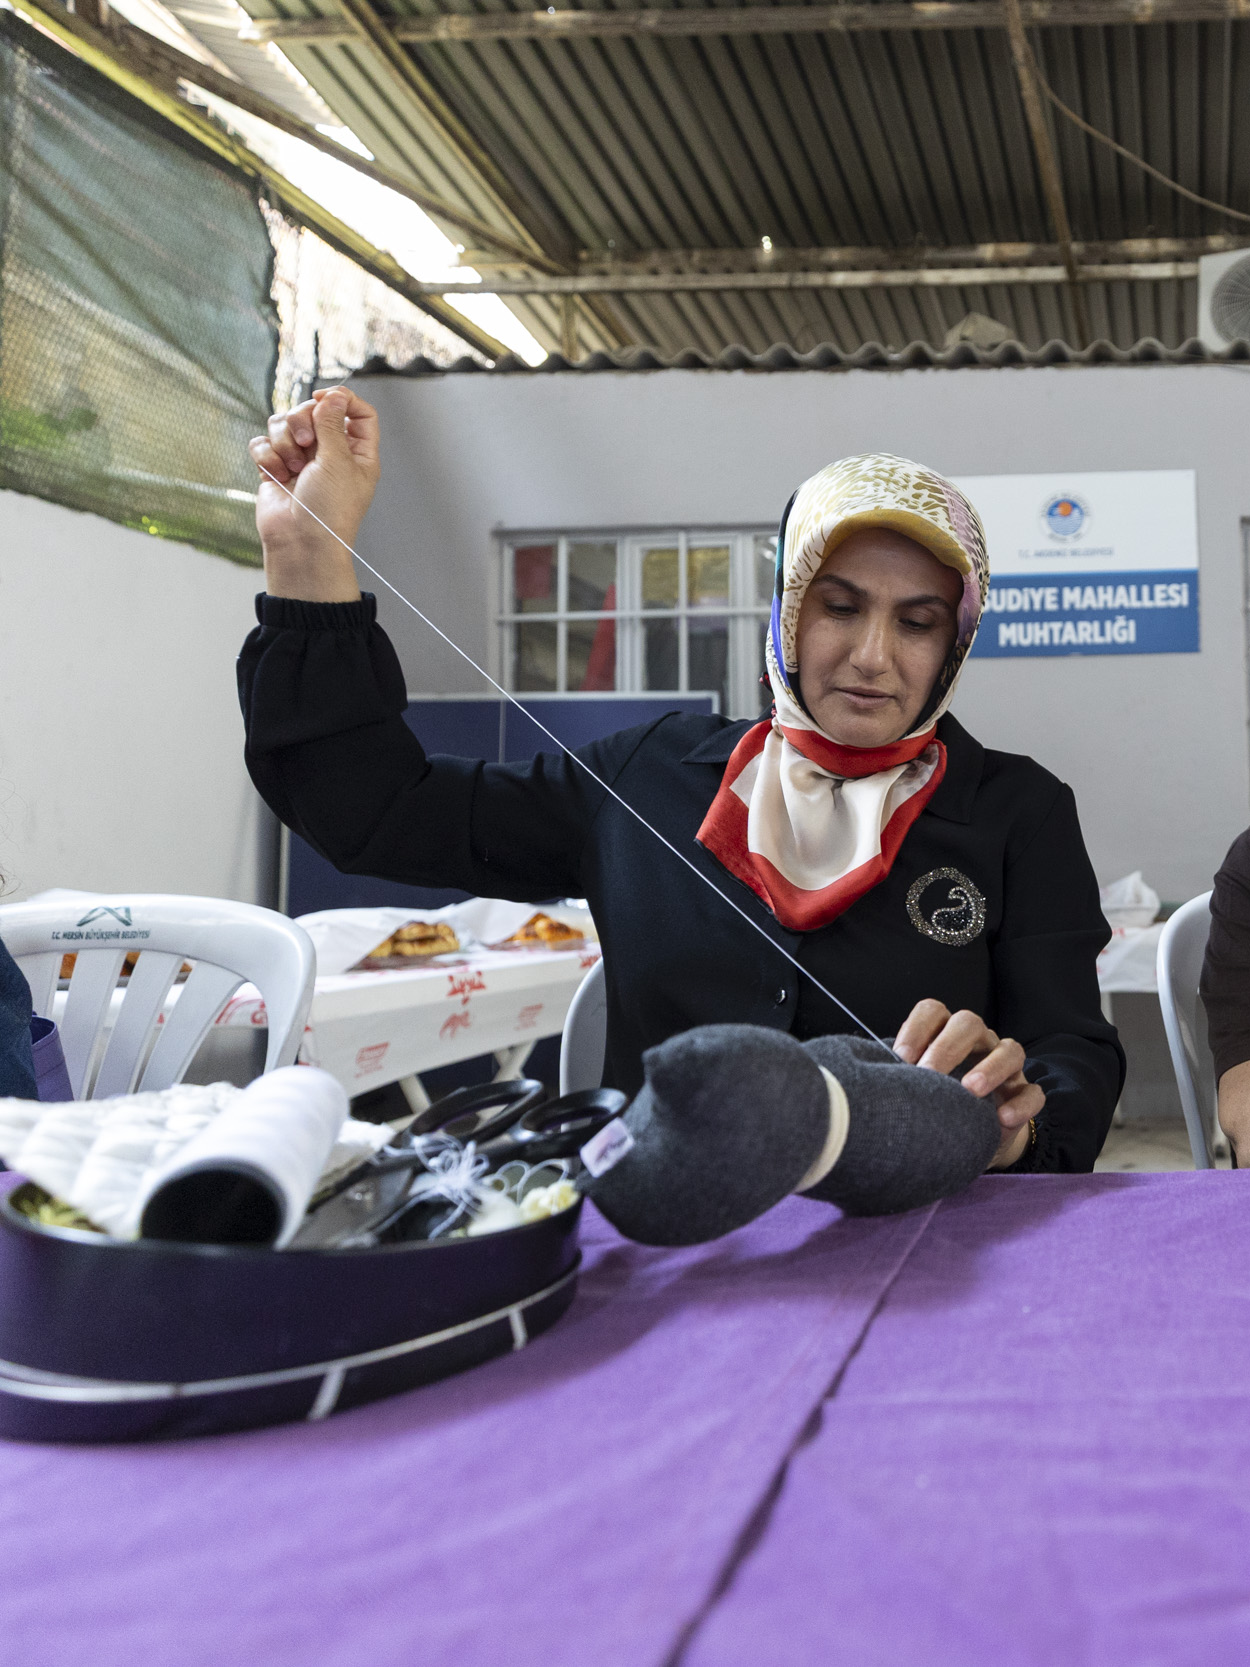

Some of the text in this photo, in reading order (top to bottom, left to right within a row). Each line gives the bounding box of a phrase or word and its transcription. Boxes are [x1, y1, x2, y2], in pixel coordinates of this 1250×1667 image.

[1063, 584, 1188, 609] MAHALLESİ
[999, 616, 1136, 647] MUHTARLIĞI
[62, 929, 84, 940] MERSİN
